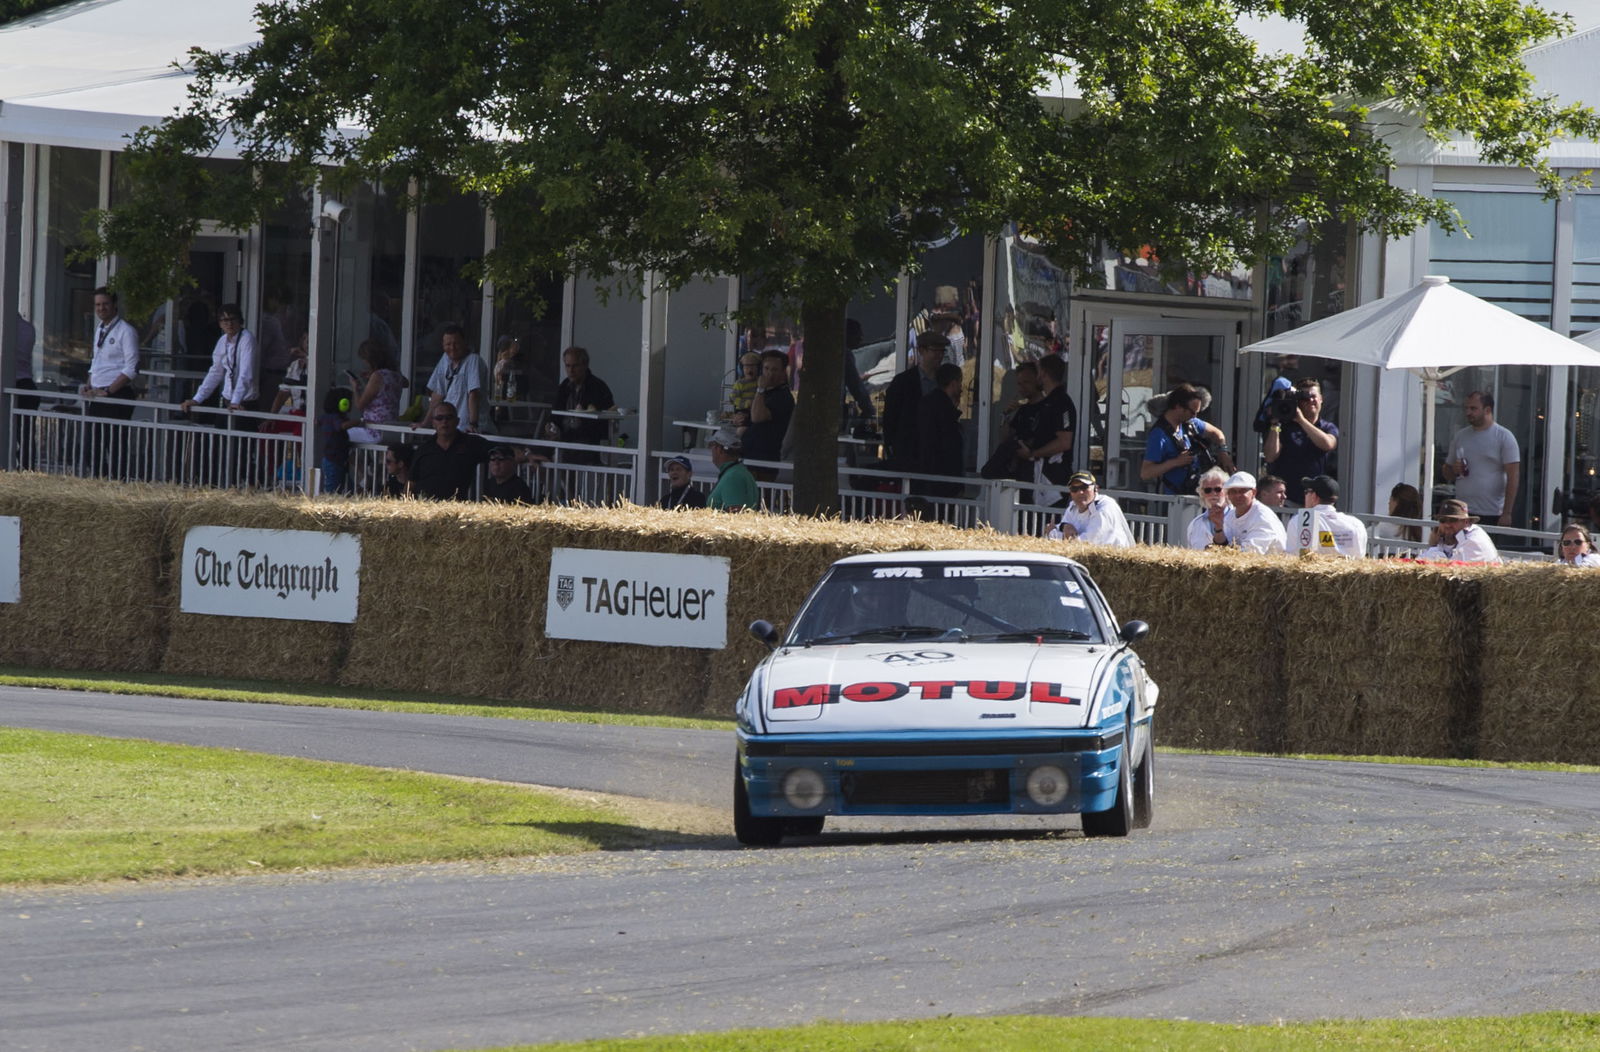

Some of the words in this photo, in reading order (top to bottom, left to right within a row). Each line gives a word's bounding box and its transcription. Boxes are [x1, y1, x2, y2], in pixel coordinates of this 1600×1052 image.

[1302, 511, 1310, 526] 2
[195, 547, 232, 588] The
[237, 549, 339, 601] Telegraph
[559, 578, 573, 589] TAG
[772, 681, 1081, 709] MOTUL
